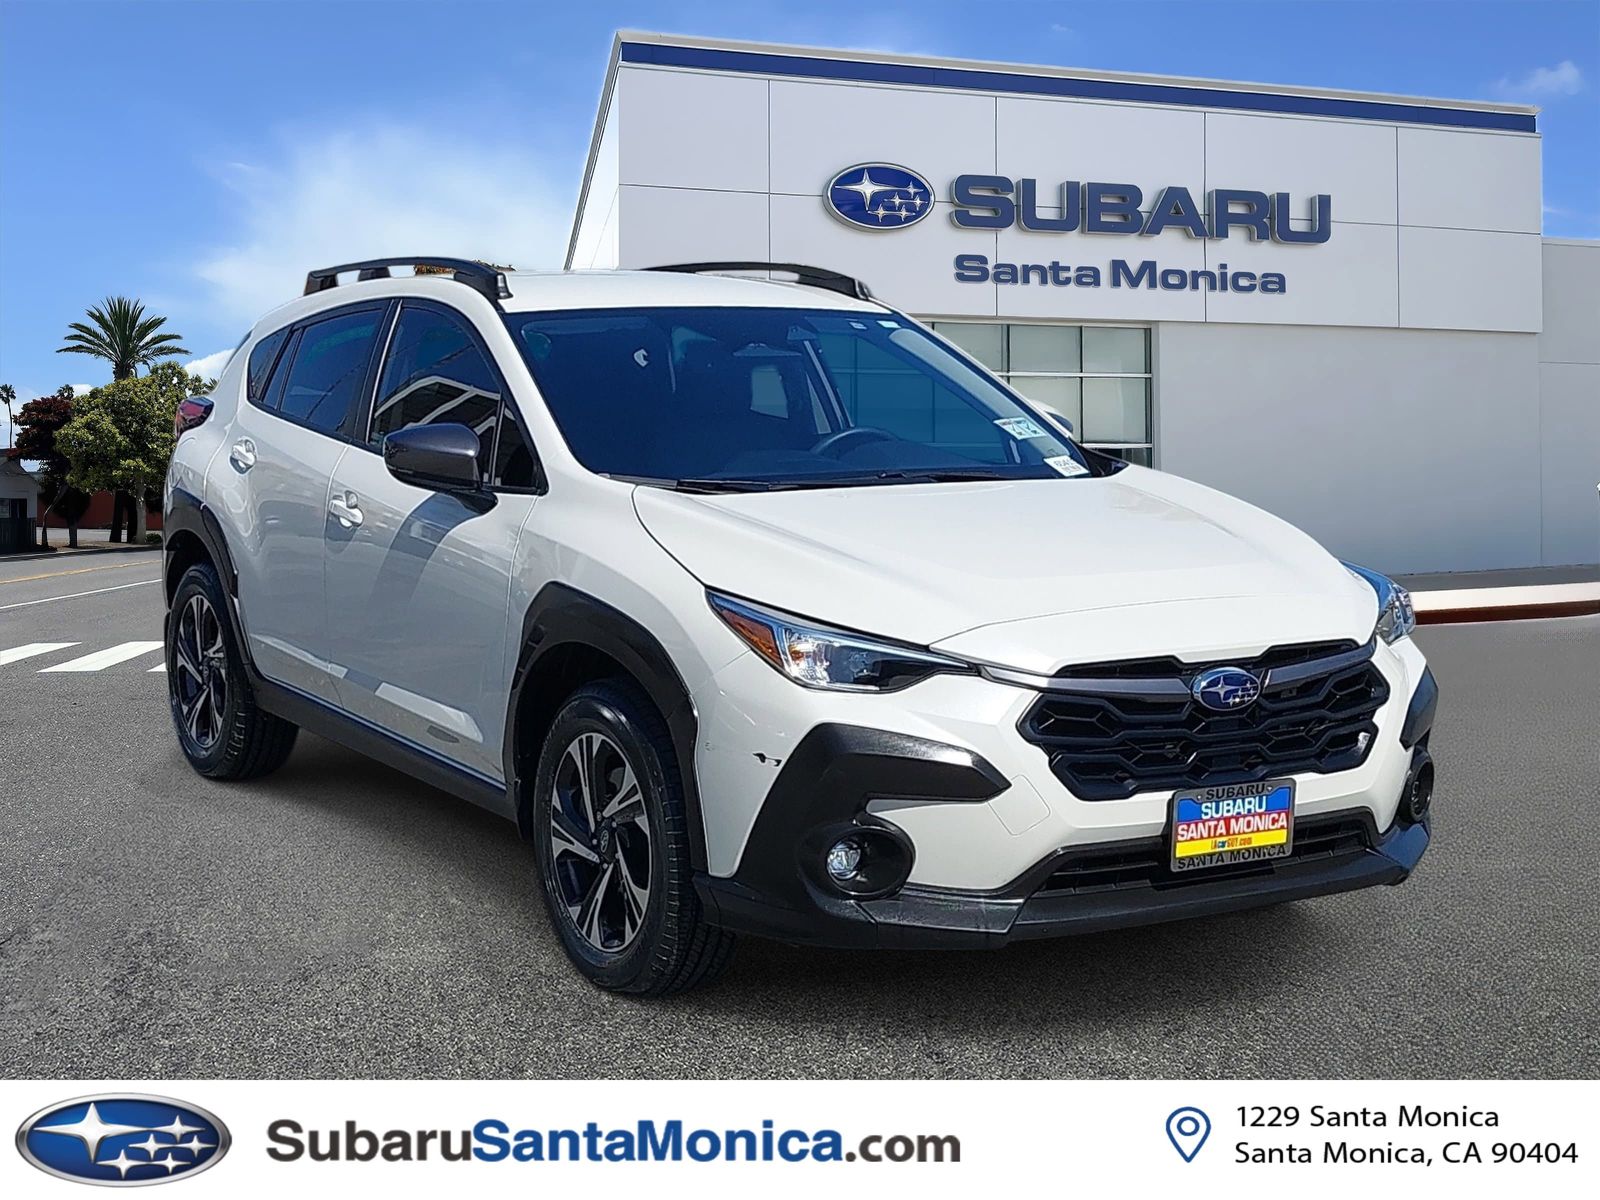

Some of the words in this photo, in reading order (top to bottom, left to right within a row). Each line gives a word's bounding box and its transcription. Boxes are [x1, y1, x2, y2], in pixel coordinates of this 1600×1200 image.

[950, 174, 1331, 244] SUBARU
[954, 254, 1101, 288] Santa
[1111, 258, 1287, 294] Monica
[1206, 783, 1266, 800] SUBARU
[1201, 795, 1267, 820] SUBARU
[1177, 819, 1227, 842] SANTA
[1229, 812, 1288, 835] MONICA
[1177, 853, 1225, 870] SANTA
[1229, 844, 1287, 863] MONICA
